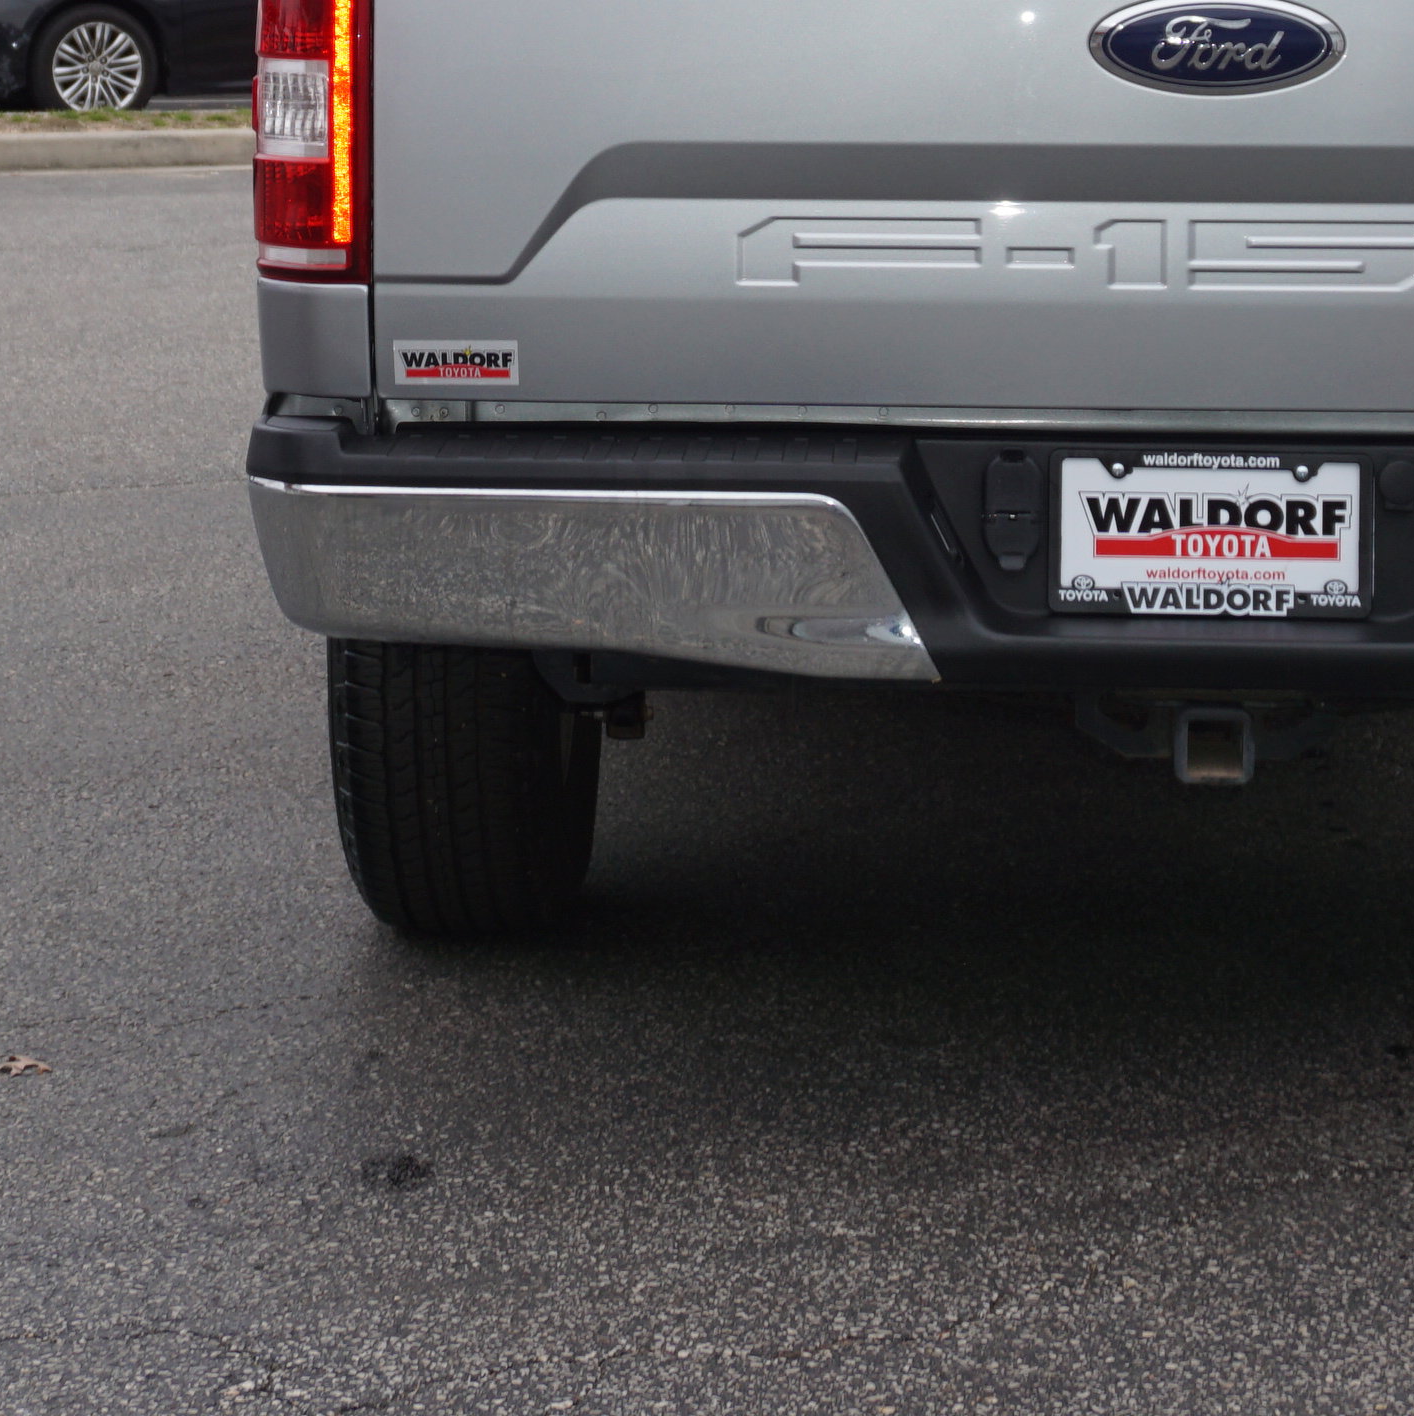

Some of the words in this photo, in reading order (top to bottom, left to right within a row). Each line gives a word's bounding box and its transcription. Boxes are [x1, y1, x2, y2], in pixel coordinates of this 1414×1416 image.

[1151, 15, 1285, 71] Ford
[401, 351, 513, 368] WALDORF
[439, 367, 481, 378] TOYOTA
[1143, 453, 1280, 469] waldorftoyota.com
[1085, 495, 1348, 536] WALDORF
[1171, 533, 1272, 558] TOYOTA
[1146, 567, 1286, 583] waldorftoyota.com
[1058, 589, 1109, 603] TOYOTA
[1125, 585, 1293, 613] WALDORF
[1310, 594, 1362, 608] TOYOTA
